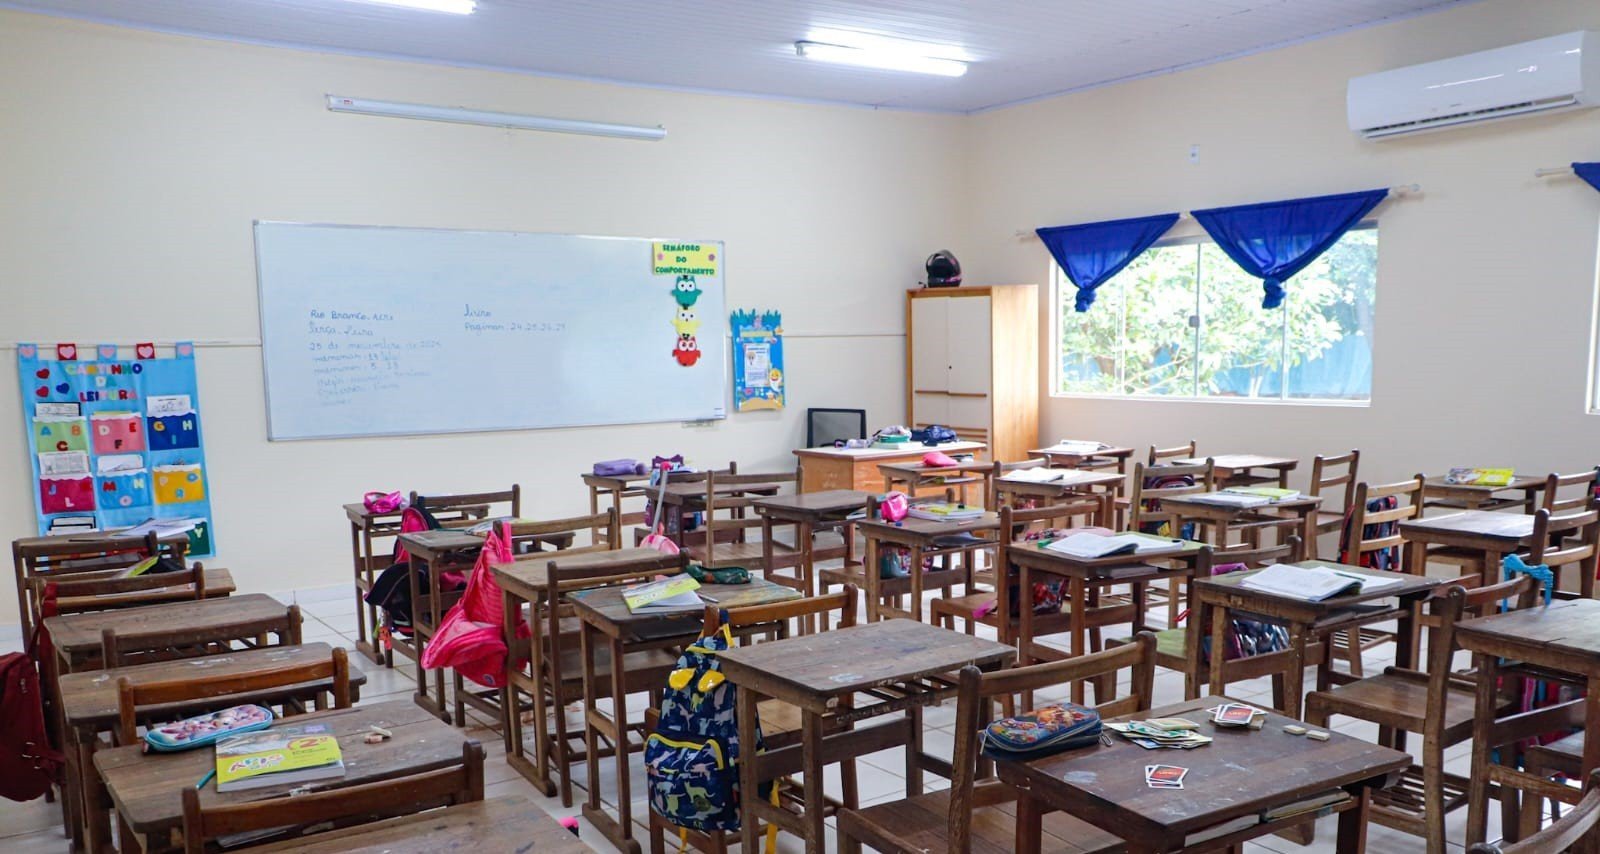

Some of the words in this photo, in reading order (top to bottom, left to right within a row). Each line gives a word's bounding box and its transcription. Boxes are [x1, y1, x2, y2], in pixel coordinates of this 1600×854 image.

[662, 244, 701, 252] SEMÁFORO
[655, 266, 715, 275] COMPORTAMENTO
[65, 364, 143, 376] CANTINHO
[96, 376, 117, 387] DA
[80, 390, 137, 403] LEITURA
[40, 425, 52, 436] A
[71, 425, 82, 437] B
[98, 425, 110, 436] D
[129, 422, 137, 433] E
[153, 420, 166, 432] G
[182, 419, 193, 431] H
[56, 440, 69, 452] C
[114, 439, 123, 450] F
[103, 481, 117, 492] M
[133, 478, 145, 489] N
[64, 496, 75, 508] L
